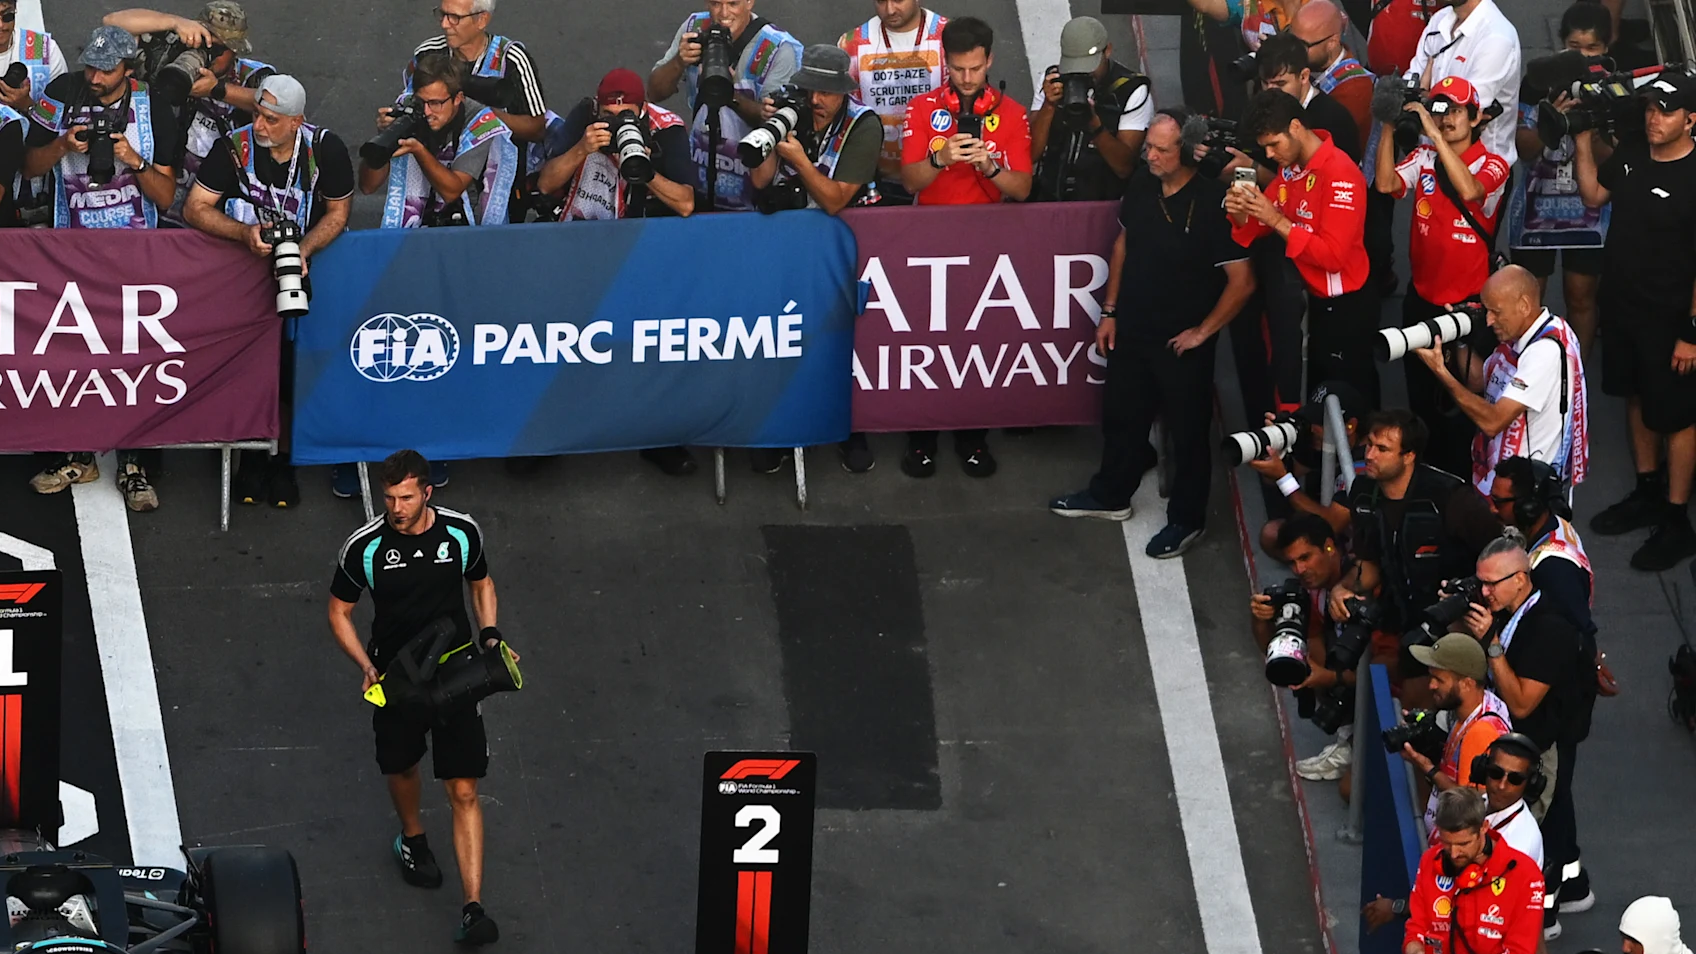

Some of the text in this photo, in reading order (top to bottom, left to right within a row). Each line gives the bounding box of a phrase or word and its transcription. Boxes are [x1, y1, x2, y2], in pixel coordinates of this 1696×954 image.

[872, 69, 924, 81] 0075-AZE
[867, 84, 931, 97] SCRUTINEER
[874, 97, 885, 106] F1
[68, 184, 140, 209] MEDIA
[78, 204, 134, 225] COURSE
[857, 253, 1109, 333] ATAR
[473, 300, 803, 365] PARC FERMÉ
[4, 611, 43, 619] Championship
[733, 805, 781, 864] 2
